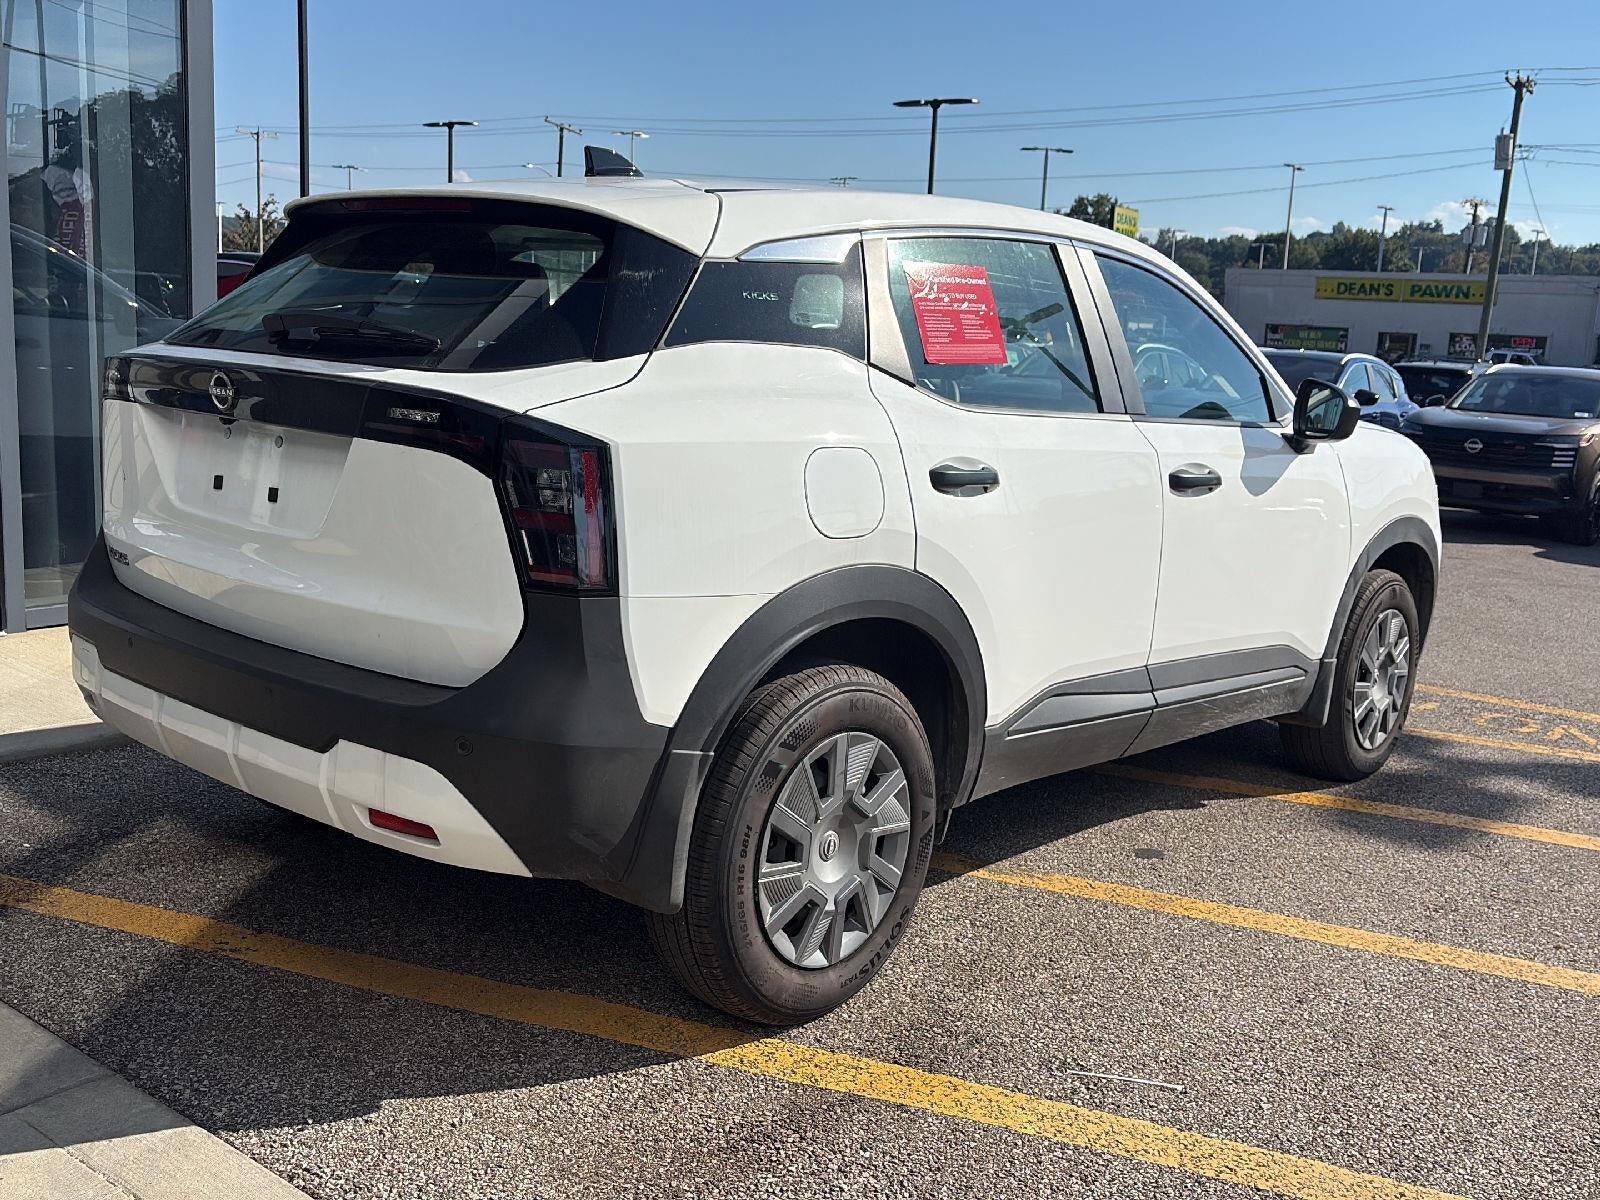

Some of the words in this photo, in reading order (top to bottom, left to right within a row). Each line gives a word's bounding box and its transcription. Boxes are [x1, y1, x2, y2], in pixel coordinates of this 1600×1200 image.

[743, 291, 779, 300] KICKS
[1336, 282, 1394, 297] DEAN'S
[1409, 283, 1471, 299] PAWN
